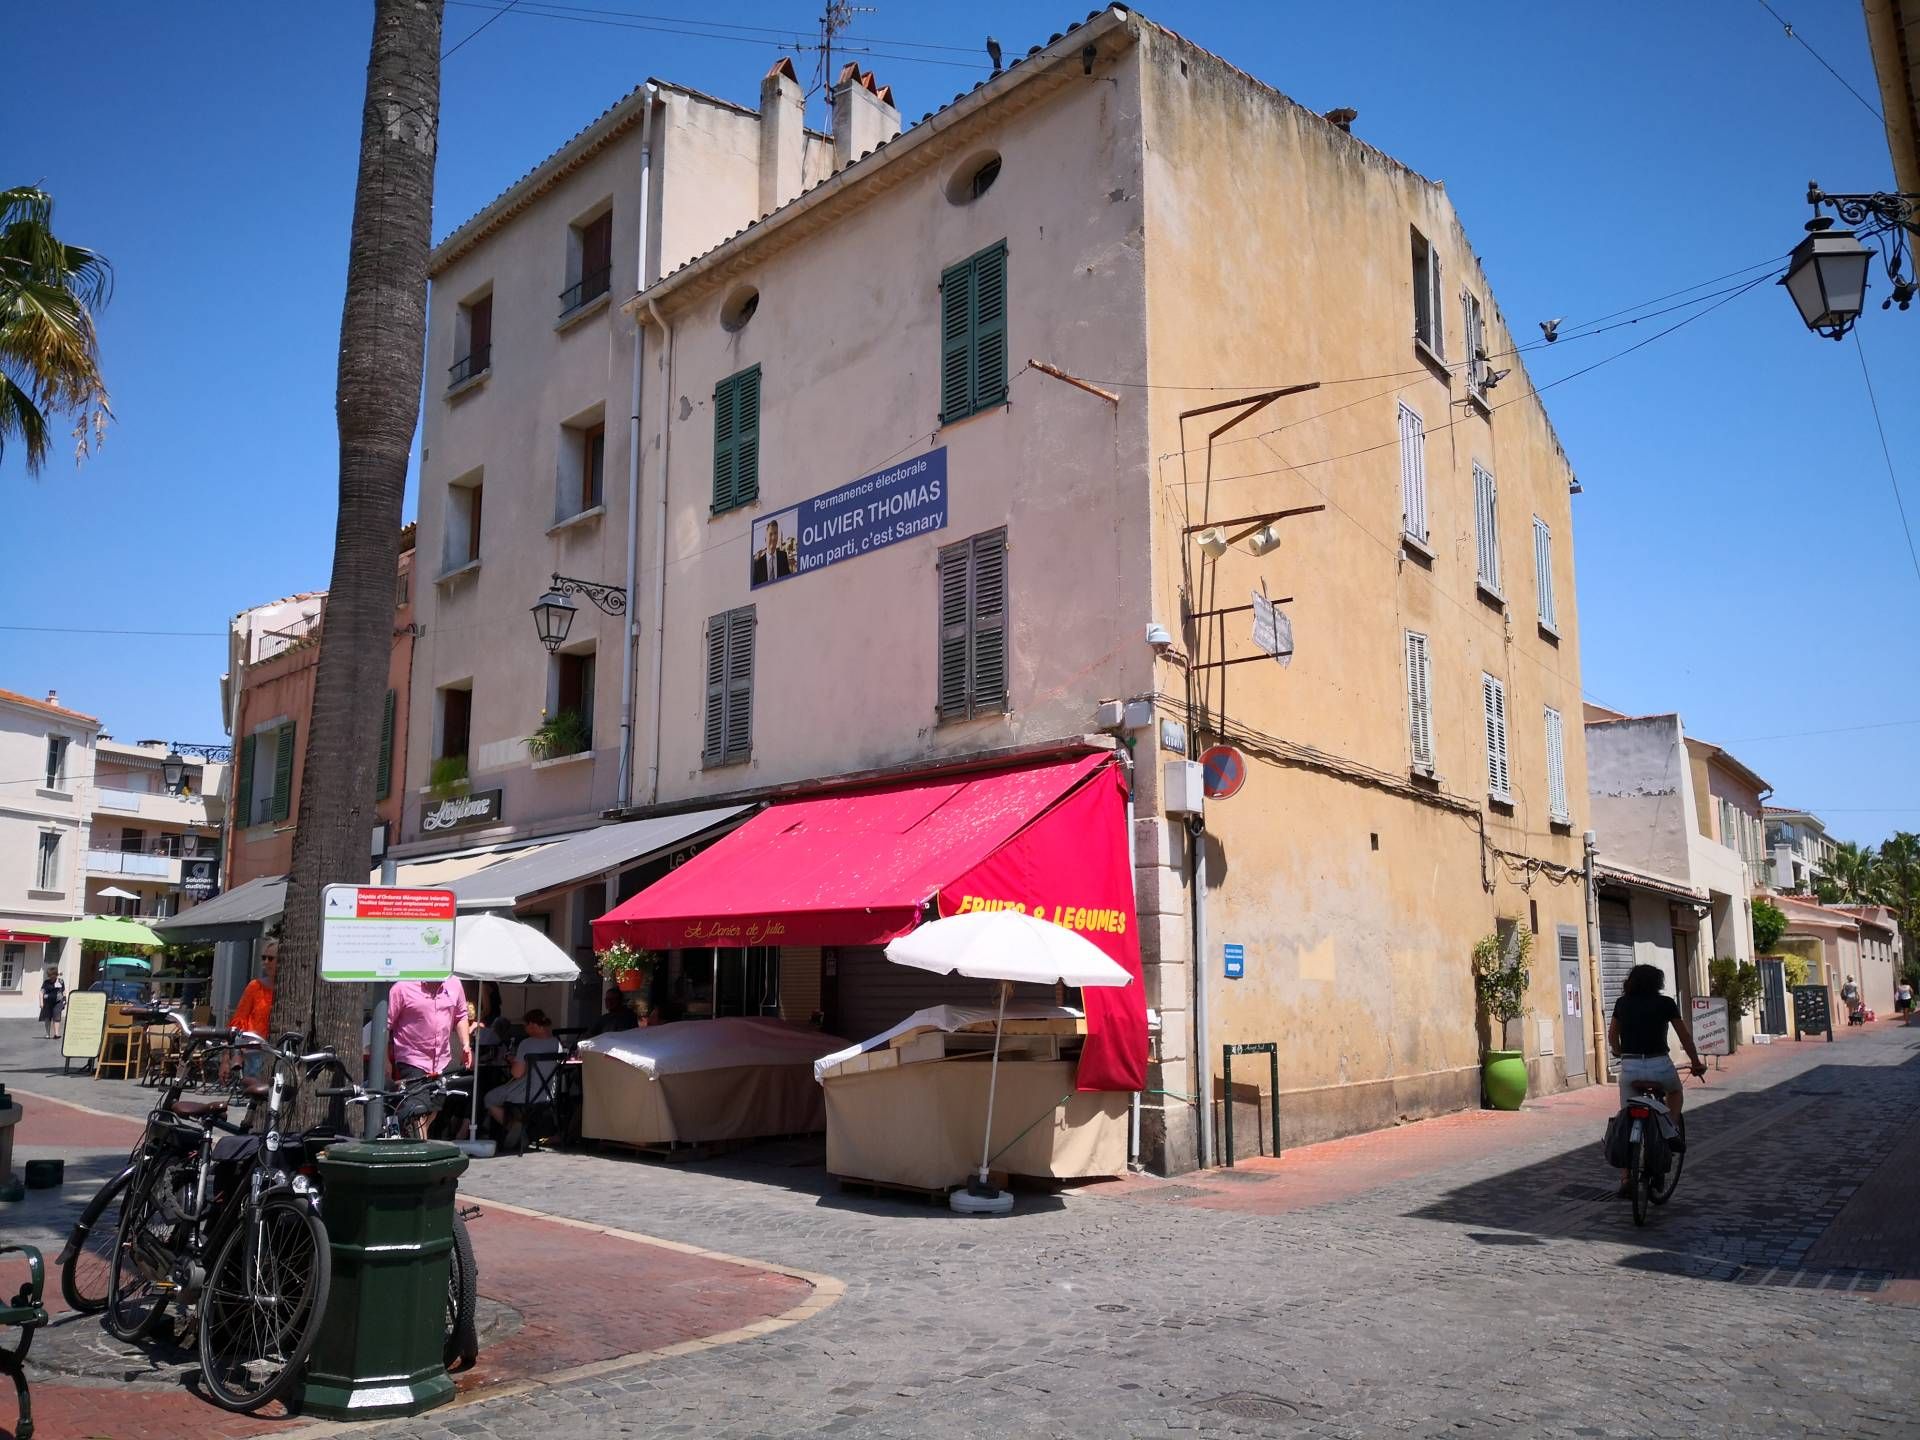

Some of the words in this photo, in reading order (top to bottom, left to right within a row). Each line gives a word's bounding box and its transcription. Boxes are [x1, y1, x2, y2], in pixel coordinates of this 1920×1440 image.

[814, 482, 874, 513] Permanence
[876, 460, 927, 489] électorale
[802, 508, 864, 546] OLIVIER
[868, 480, 941, 523] THOMAS
[800, 554, 825, 571] Mon
[827, 542, 859, 566] parti,
[861, 526, 893, 550] c'est
[896, 512, 944, 537] Sanary
[670, 853, 687, 870] Le
[746, 922, 758, 936] de
[751, 920, 785, 944] Julia
[1053, 905, 1127, 935] LEGUMES
[1692, 1000, 1710, 1009] ICI
